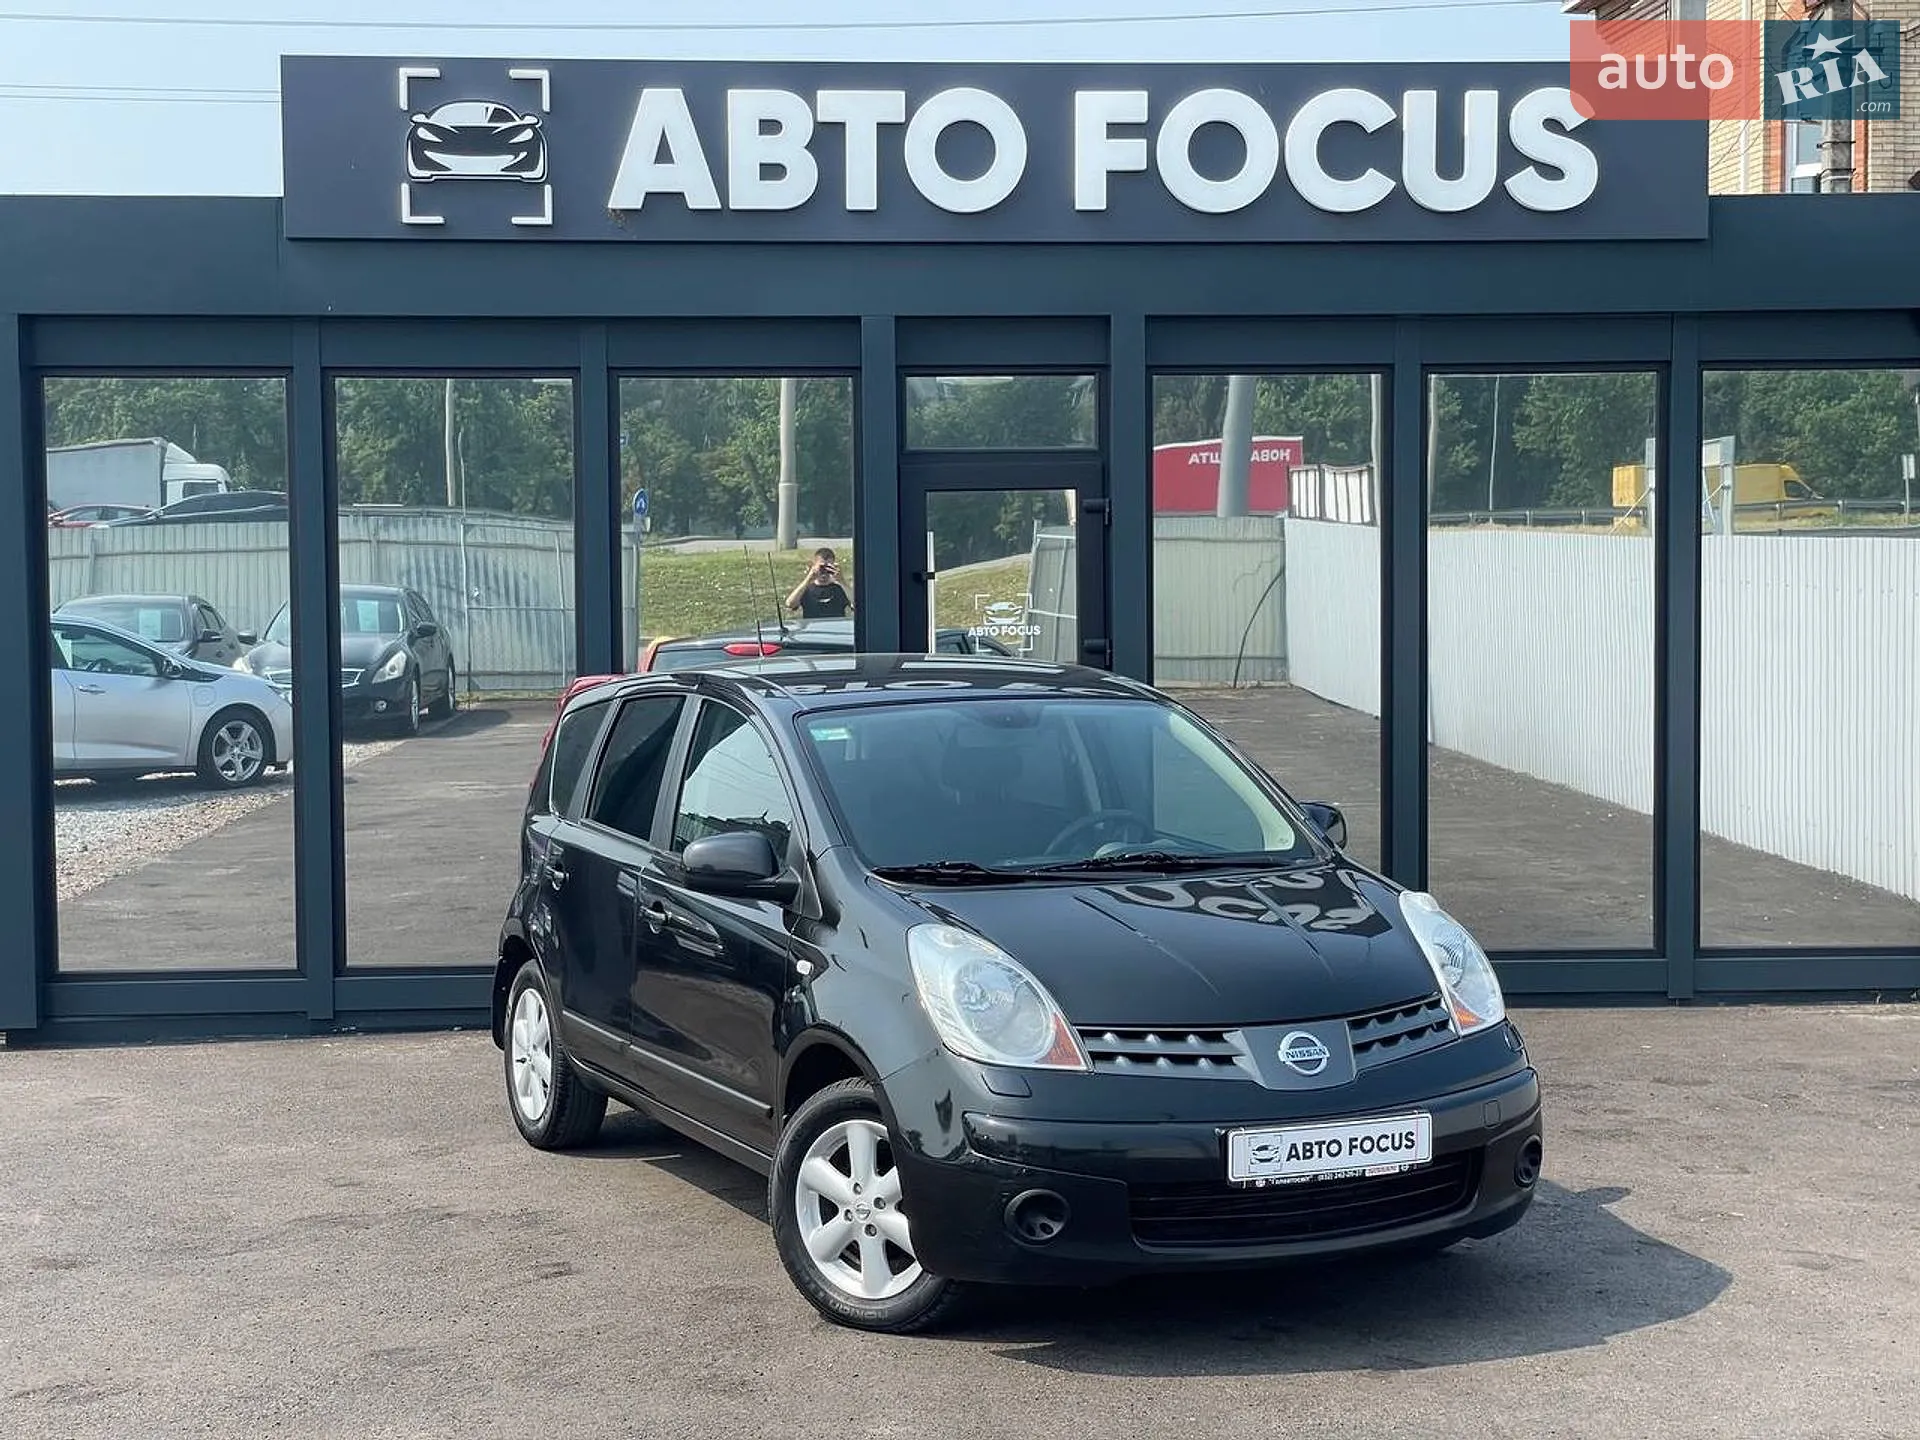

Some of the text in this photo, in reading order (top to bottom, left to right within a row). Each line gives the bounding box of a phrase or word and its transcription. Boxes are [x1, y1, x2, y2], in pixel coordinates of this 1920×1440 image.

[607, 86, 1600, 214] АВТО FOCUS
[967, 624, 1042, 638] АВТО FOCUS
[1284, 1046, 1328, 1060] NISSAN
[1286, 1130, 1416, 1163] АВТО FOCUS
